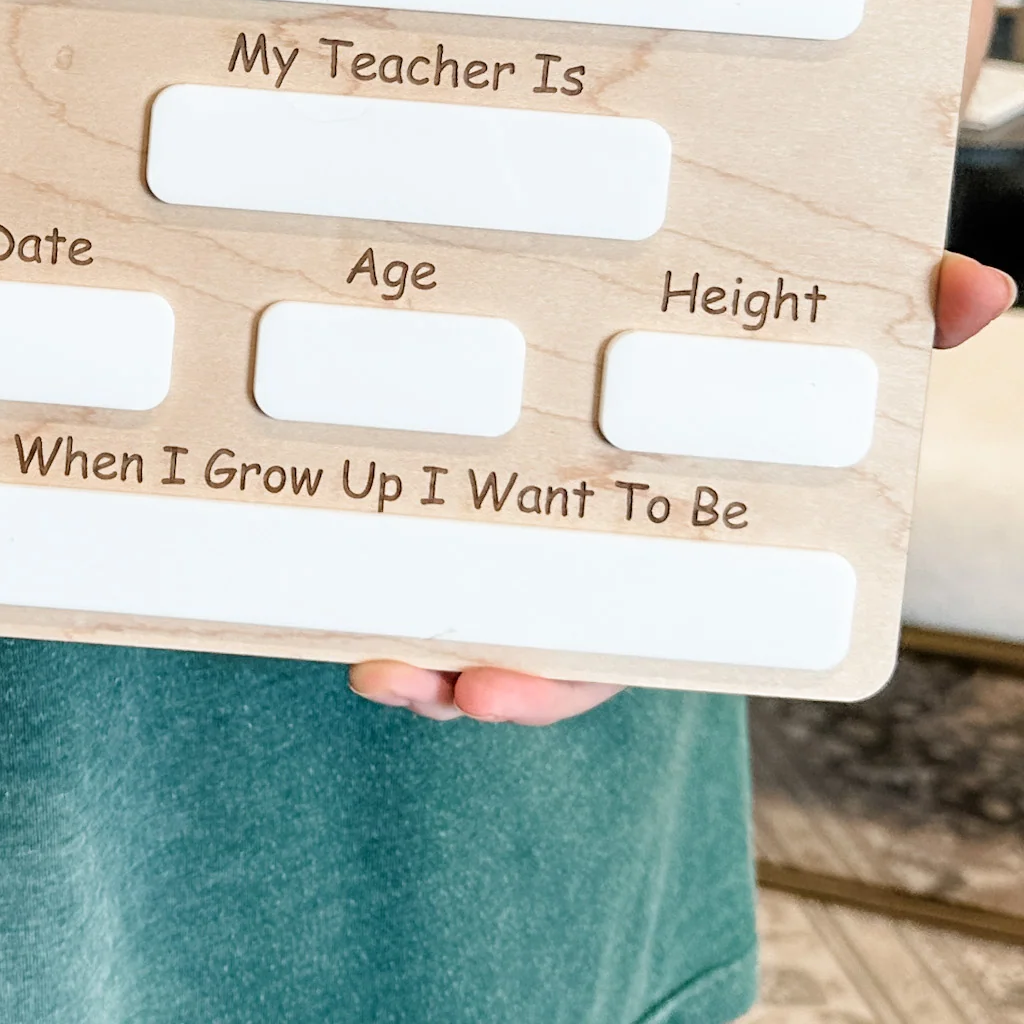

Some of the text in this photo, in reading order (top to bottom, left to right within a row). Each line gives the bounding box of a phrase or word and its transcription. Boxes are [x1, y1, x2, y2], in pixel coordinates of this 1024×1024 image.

[227, 32, 586, 97] My Teacher Is
[346, 247, 438, 301] Age
[661, 270, 828, 332] Height
[14, 433, 749, 531] When I Grow Up I Want To Be
